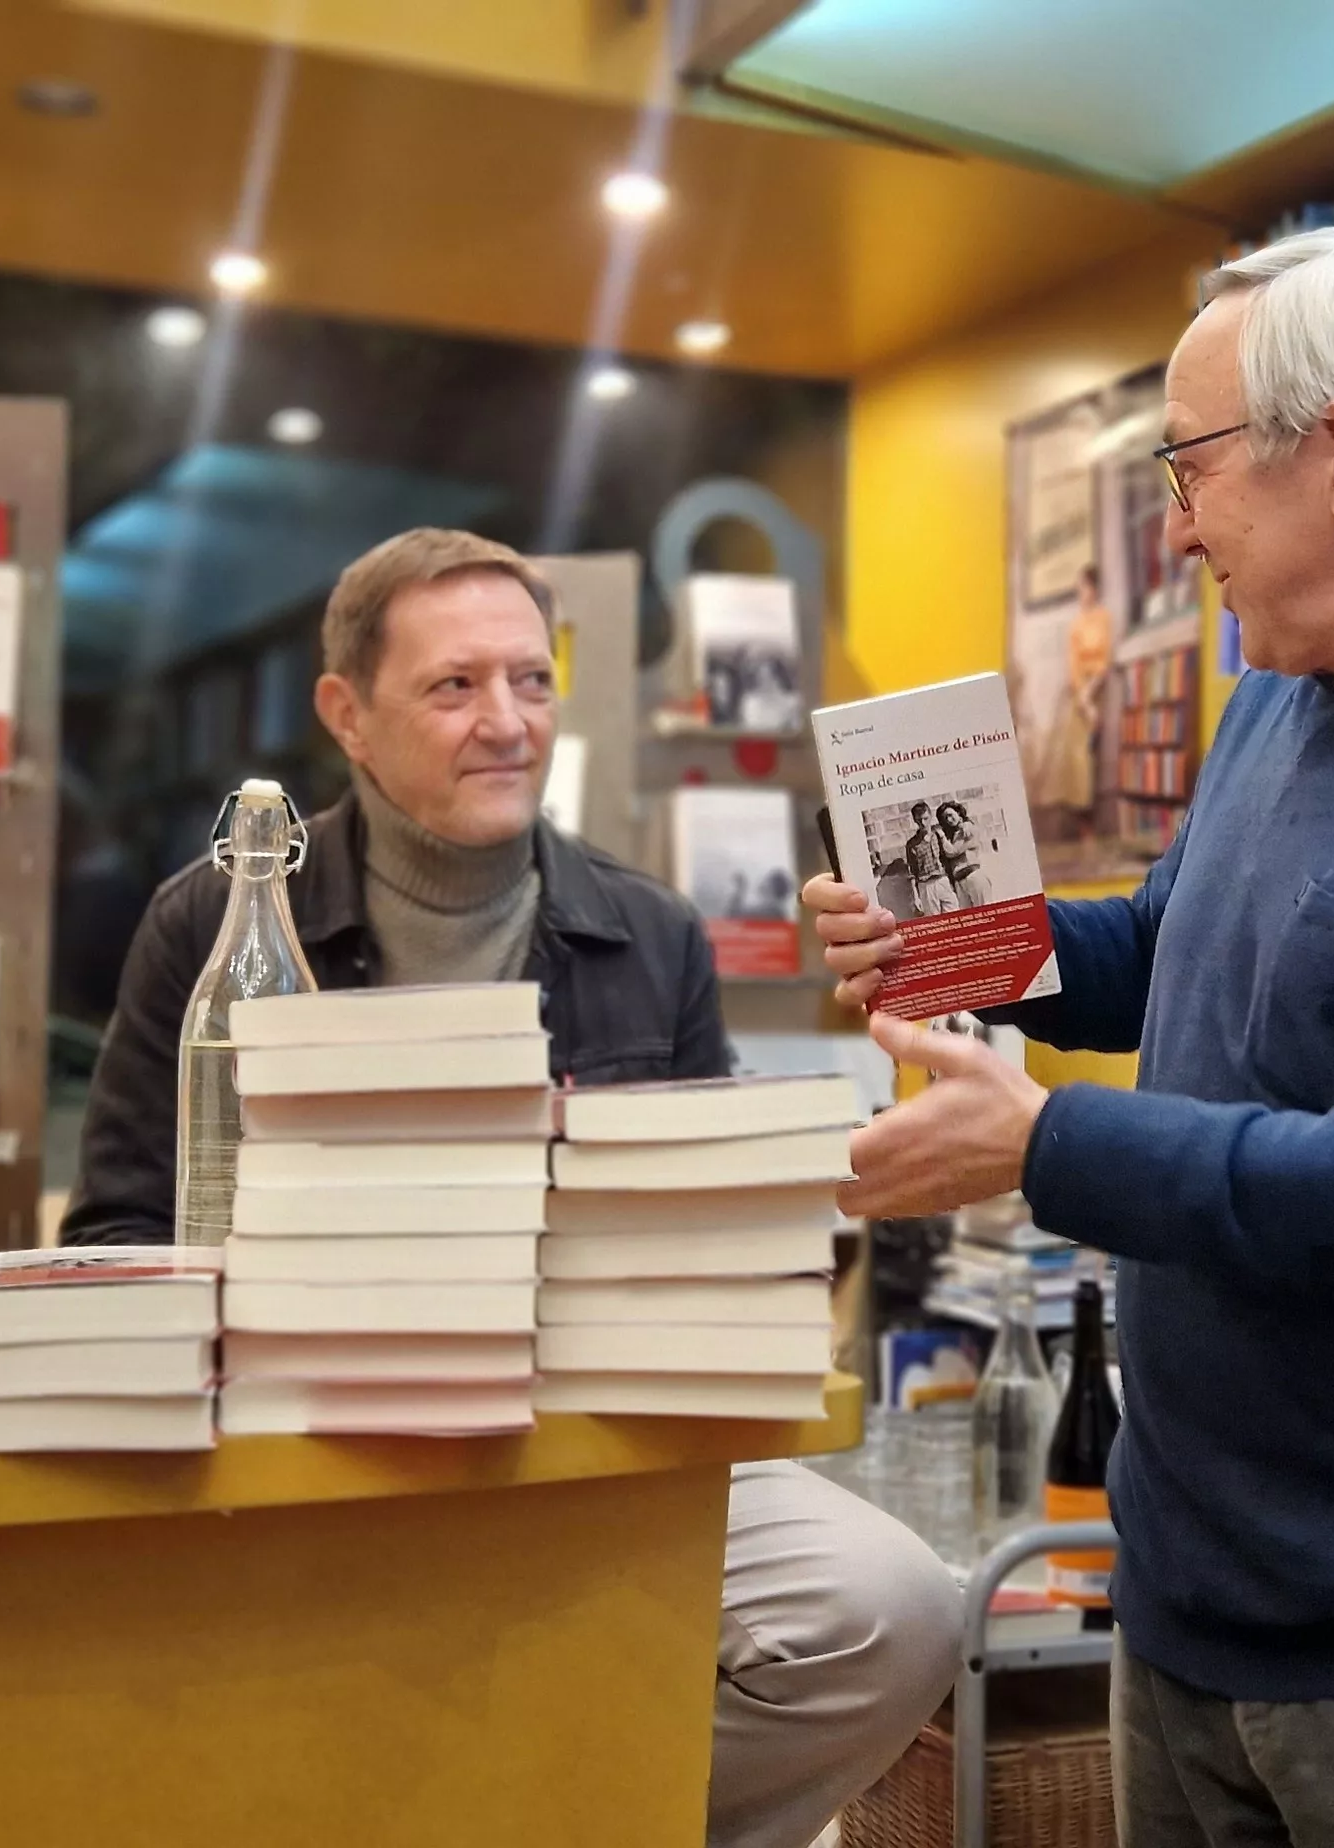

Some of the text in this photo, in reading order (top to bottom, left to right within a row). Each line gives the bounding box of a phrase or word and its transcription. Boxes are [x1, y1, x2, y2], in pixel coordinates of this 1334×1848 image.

[835, 729, 1011, 778] Ignacio Martínez de Pisón
[838, 769, 926, 797] Ropa de casa
